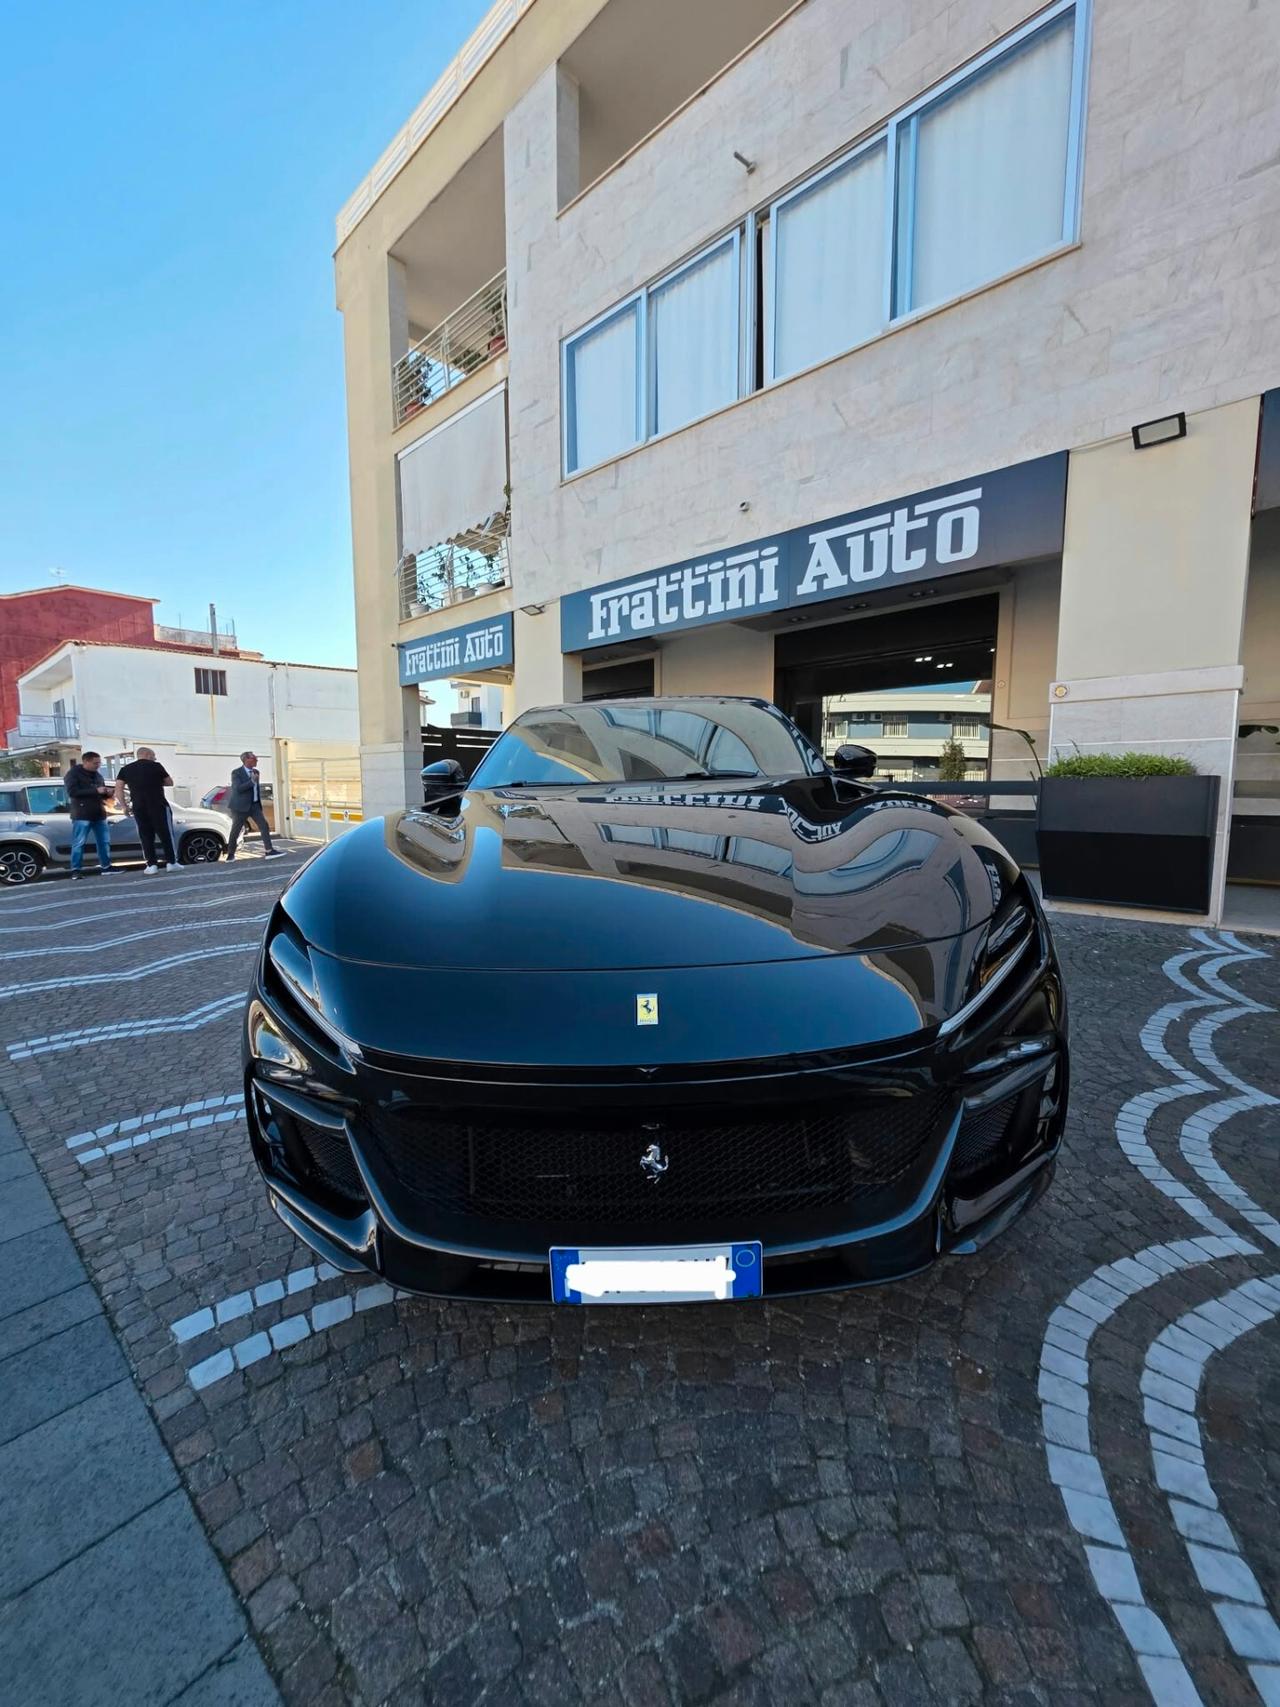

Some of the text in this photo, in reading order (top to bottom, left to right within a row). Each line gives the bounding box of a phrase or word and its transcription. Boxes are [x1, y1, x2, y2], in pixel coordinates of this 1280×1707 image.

[588, 487, 983, 640] Frattini Auto
[405, 625, 503, 676] Frattini Auto
